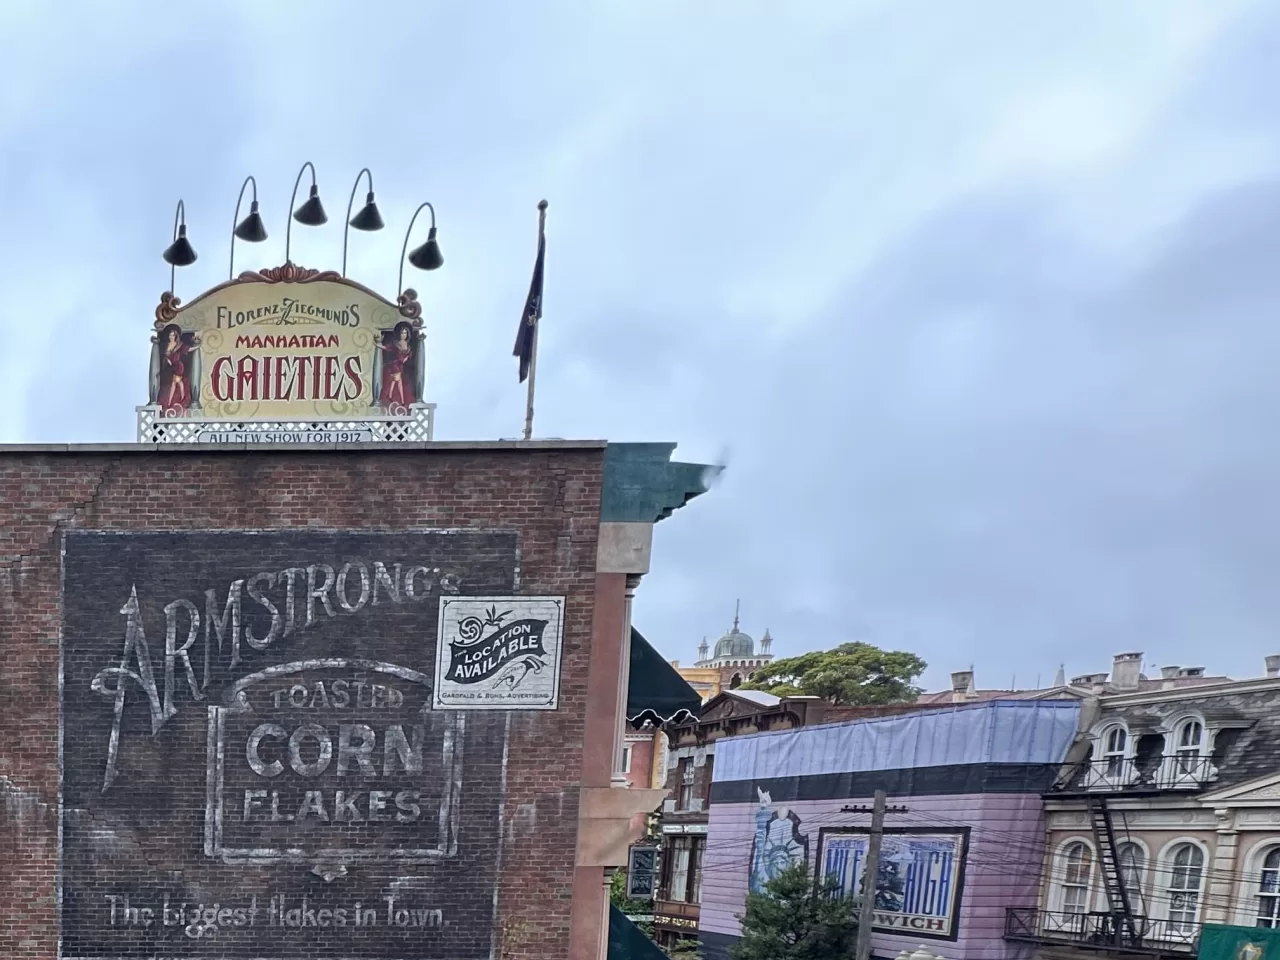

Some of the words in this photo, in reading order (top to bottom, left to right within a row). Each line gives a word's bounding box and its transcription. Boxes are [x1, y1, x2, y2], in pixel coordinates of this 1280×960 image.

[216, 303, 279, 330] FLORENZ
[235, 334, 339, 348] MANHATTAN
[210, 354, 363, 402] GAIETIES
[235, 434, 262, 443] NEW
[265, 433, 304, 443] SHOW
[306, 433, 332, 443] FOR
[454, 635, 539, 678] AVAILABLE
[464, 624, 531, 664] LOCATION
[269, 680, 405, 710] TOASTED
[245, 722, 421, 777] CORN
[243, 789, 422, 823] FLAKES
[105, 893, 155, 927] The
[161, 893, 258, 939] biggest
[353, 900, 378, 927] in
